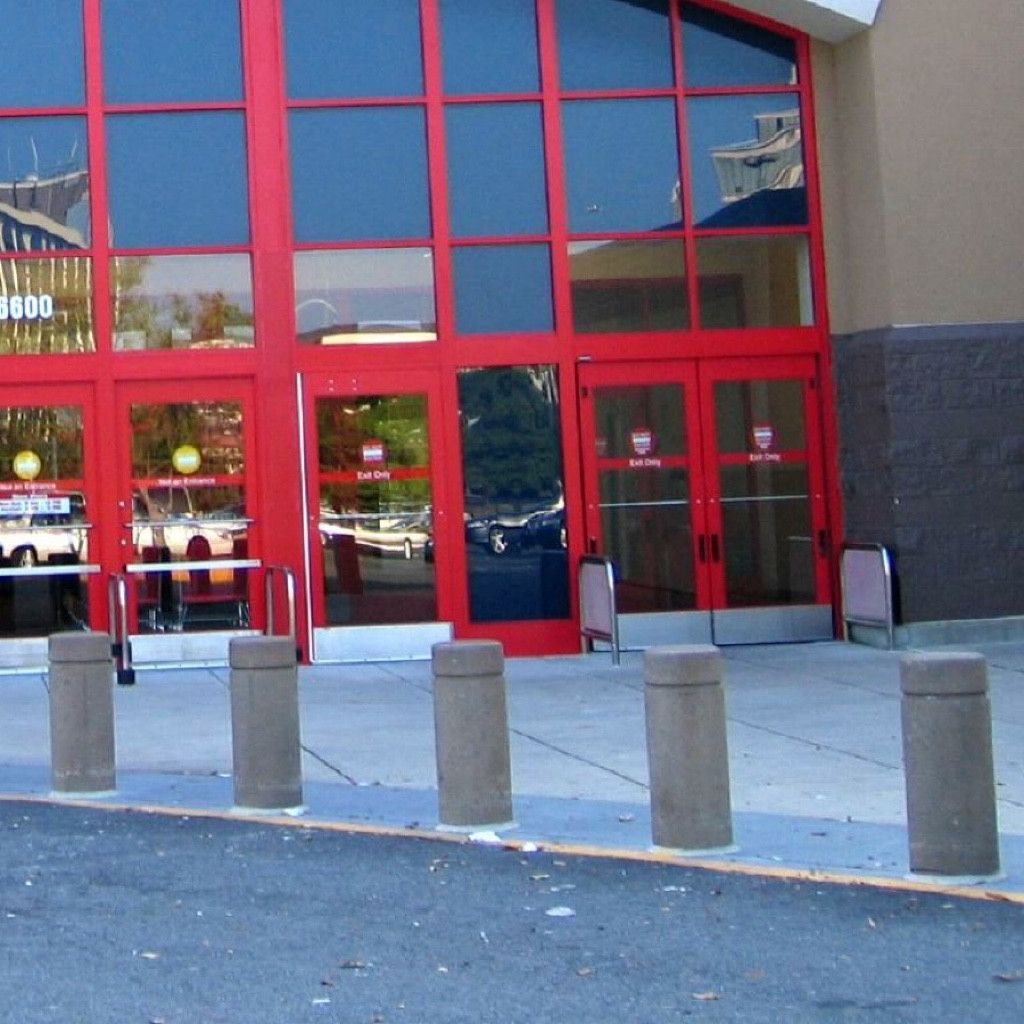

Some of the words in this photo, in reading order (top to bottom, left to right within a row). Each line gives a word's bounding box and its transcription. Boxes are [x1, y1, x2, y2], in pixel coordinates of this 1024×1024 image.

[629, 459, 643, 467] Exit
[644, 458, 661, 468] Only
[749, 453, 762, 462] Exit
[765, 453, 781, 463] Only
[357, 471, 372, 480] Exit
[373, 470, 391, 481] Only
[24, 482, 56, 491] Entrance
[183, 478, 216, 486] Entrance
